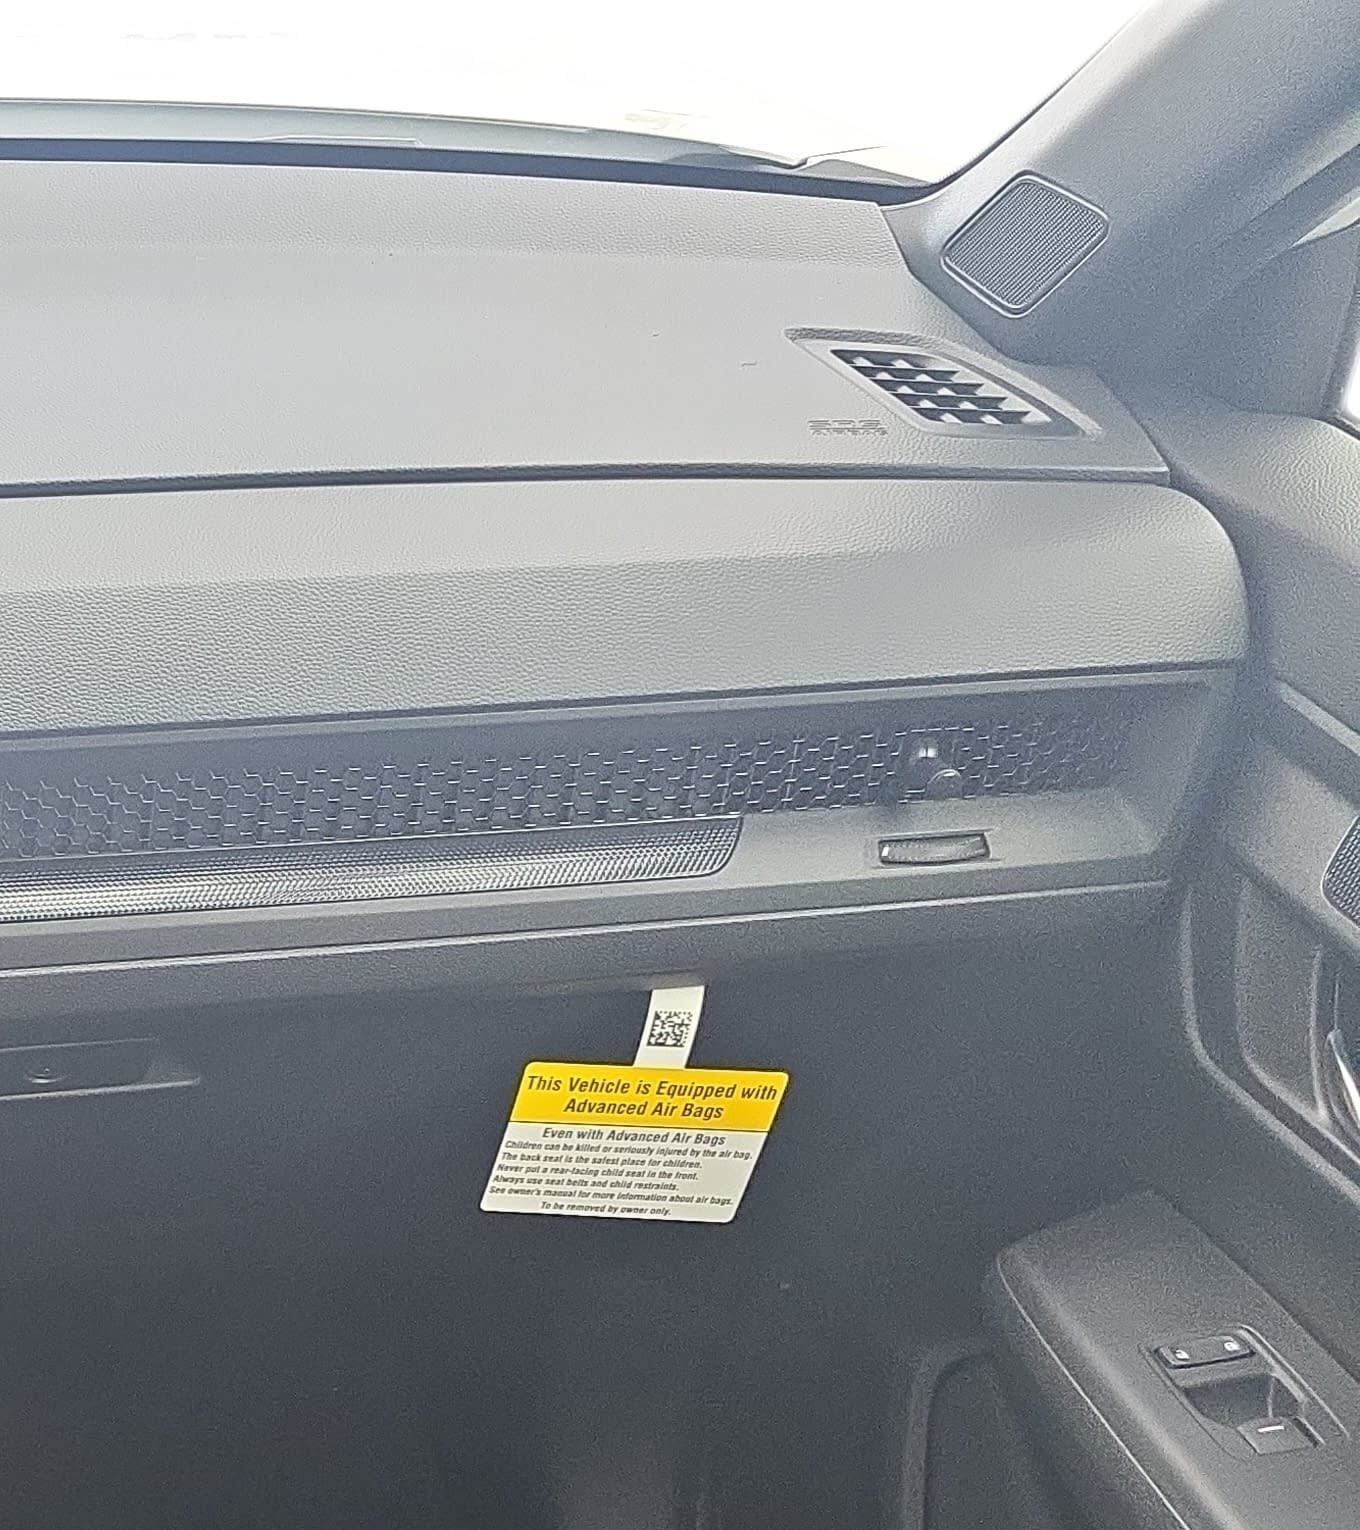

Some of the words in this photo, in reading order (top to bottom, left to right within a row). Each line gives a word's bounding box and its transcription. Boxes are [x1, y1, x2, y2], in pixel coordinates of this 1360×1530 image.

[528, 1075, 562, 1091] This
[569, 1077, 629, 1094] Vehicle
[637, 1081, 649, 1095] is
[657, 1082, 735, 1100] Equipped
[740, 1084, 777, 1100] with
[564, 1098, 646, 1116] Advanced
[651, 1103, 677, 1117] Air
[682, 1104, 724, 1119] Bags
[542, 1127, 573, 1138] Even
[577, 1129, 604, 1140] with
[606, 1129, 670, 1143] Advanced
[672, 1132, 691, 1144] Air
[694, 1134, 727, 1146] Bags
[505, 1141, 543, 1150] Children
[544, 1143, 561, 1151] can
[562, 1143, 573, 1151] be
[575, 1144, 601, 1152] killed
[613, 1146, 654, 1155] seriously
[656, 1147, 688, 1156] injured
[690, 1148, 701, 1158] by
[702, 1148, 717, 1157] the
[718, 1150, 731, 1158] air
[734, 1151, 753, 1160] bag.
[502, 1152, 518, 1160] The
[520, 1153, 540, 1161] back
[575, 1155, 589, 1163] the
[592, 1157, 619, 1165] safest
[620, 1159, 645, 1167] place
[648, 1159, 661, 1167] for
[663, 1160, 703, 1169] children.
[497, 1164, 524, 1172] Never
[525, 1165, 540, 1174] put
[550, 1165, 600, 1177] rear-facing
[601, 1167, 623, 1177] child
[625, 1169, 646, 1178] seat
[647, 1169, 656, 1177] in
[658, 1169, 673, 1179] the
[674, 1170, 699, 1180] front.
[493, 1175, 525, 1185] Always
[545, 1178, 564, 1186] seat
[566, 1179, 589, 1187] belts
[590, 1180, 608, 1188] and
[610, 1181, 632, 1189] child
[634, 1181, 679, 1191] restraints.
[488, 1186, 506, 1194] See
[508, 1188, 541, 1196] owner's
[543, 1189, 576, 1197] manual
[578, 1190, 591, 1198] for
[617, 1192, 668, 1202] information
[669, 1193, 695, 1203] about
[696, 1195, 709, 1203] air
[710, 1196, 734, 1206] bags.
[541, 1201, 552, 1209] To
[553, 1202, 564, 1210] be
[566, 1203, 606, 1212] removed
[608, 1205, 618, 1214] by
[620, 1205, 648, 1214] owner
[650, 1206, 671, 1216] only.
